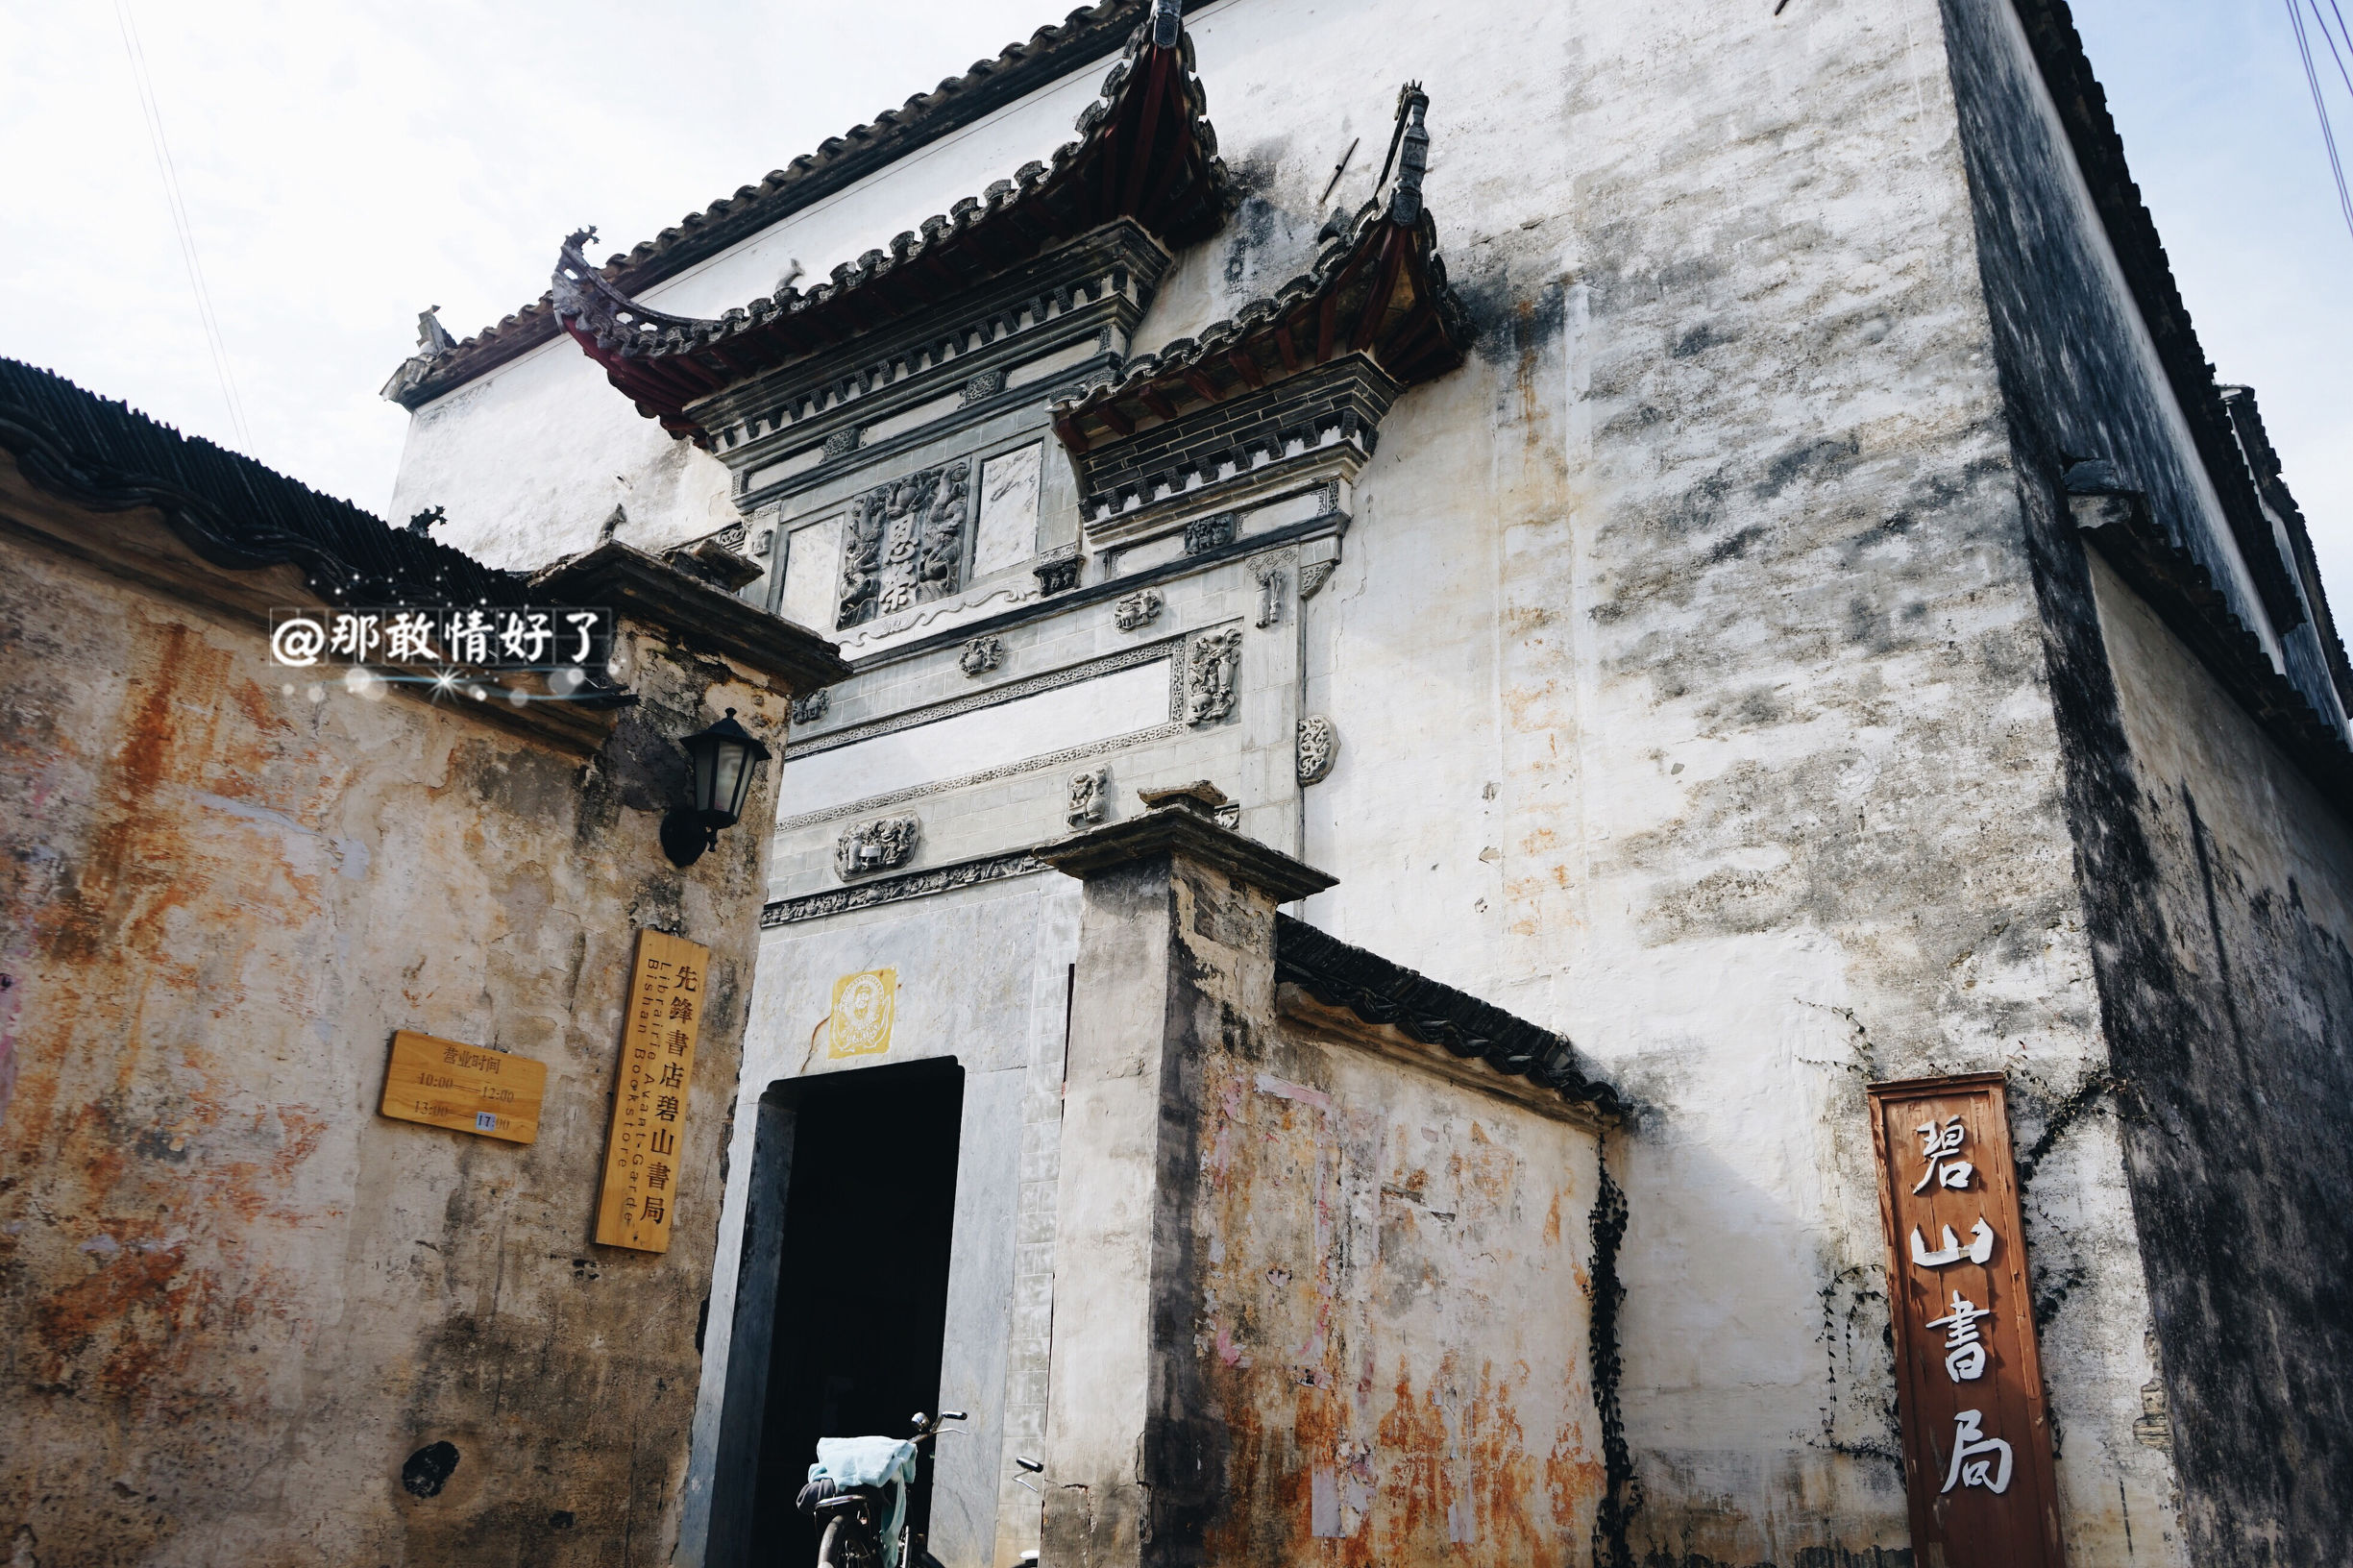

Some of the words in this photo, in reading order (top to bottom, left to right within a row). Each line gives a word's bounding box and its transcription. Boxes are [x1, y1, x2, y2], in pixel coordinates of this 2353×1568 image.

[638, 959, 659, 1034] Bishan
[648, 962, 672, 1060] Librairie
[443, 1046, 502, 1074] 营业时间
[618, 1048, 646, 1167] Bookstore
[640, 966, 698, 1225] 先鋒書店碧山書局
[624, 1073, 655, 1221] Avant-Garde
[1911, 1115, 2013, 1494] 碧山書局
